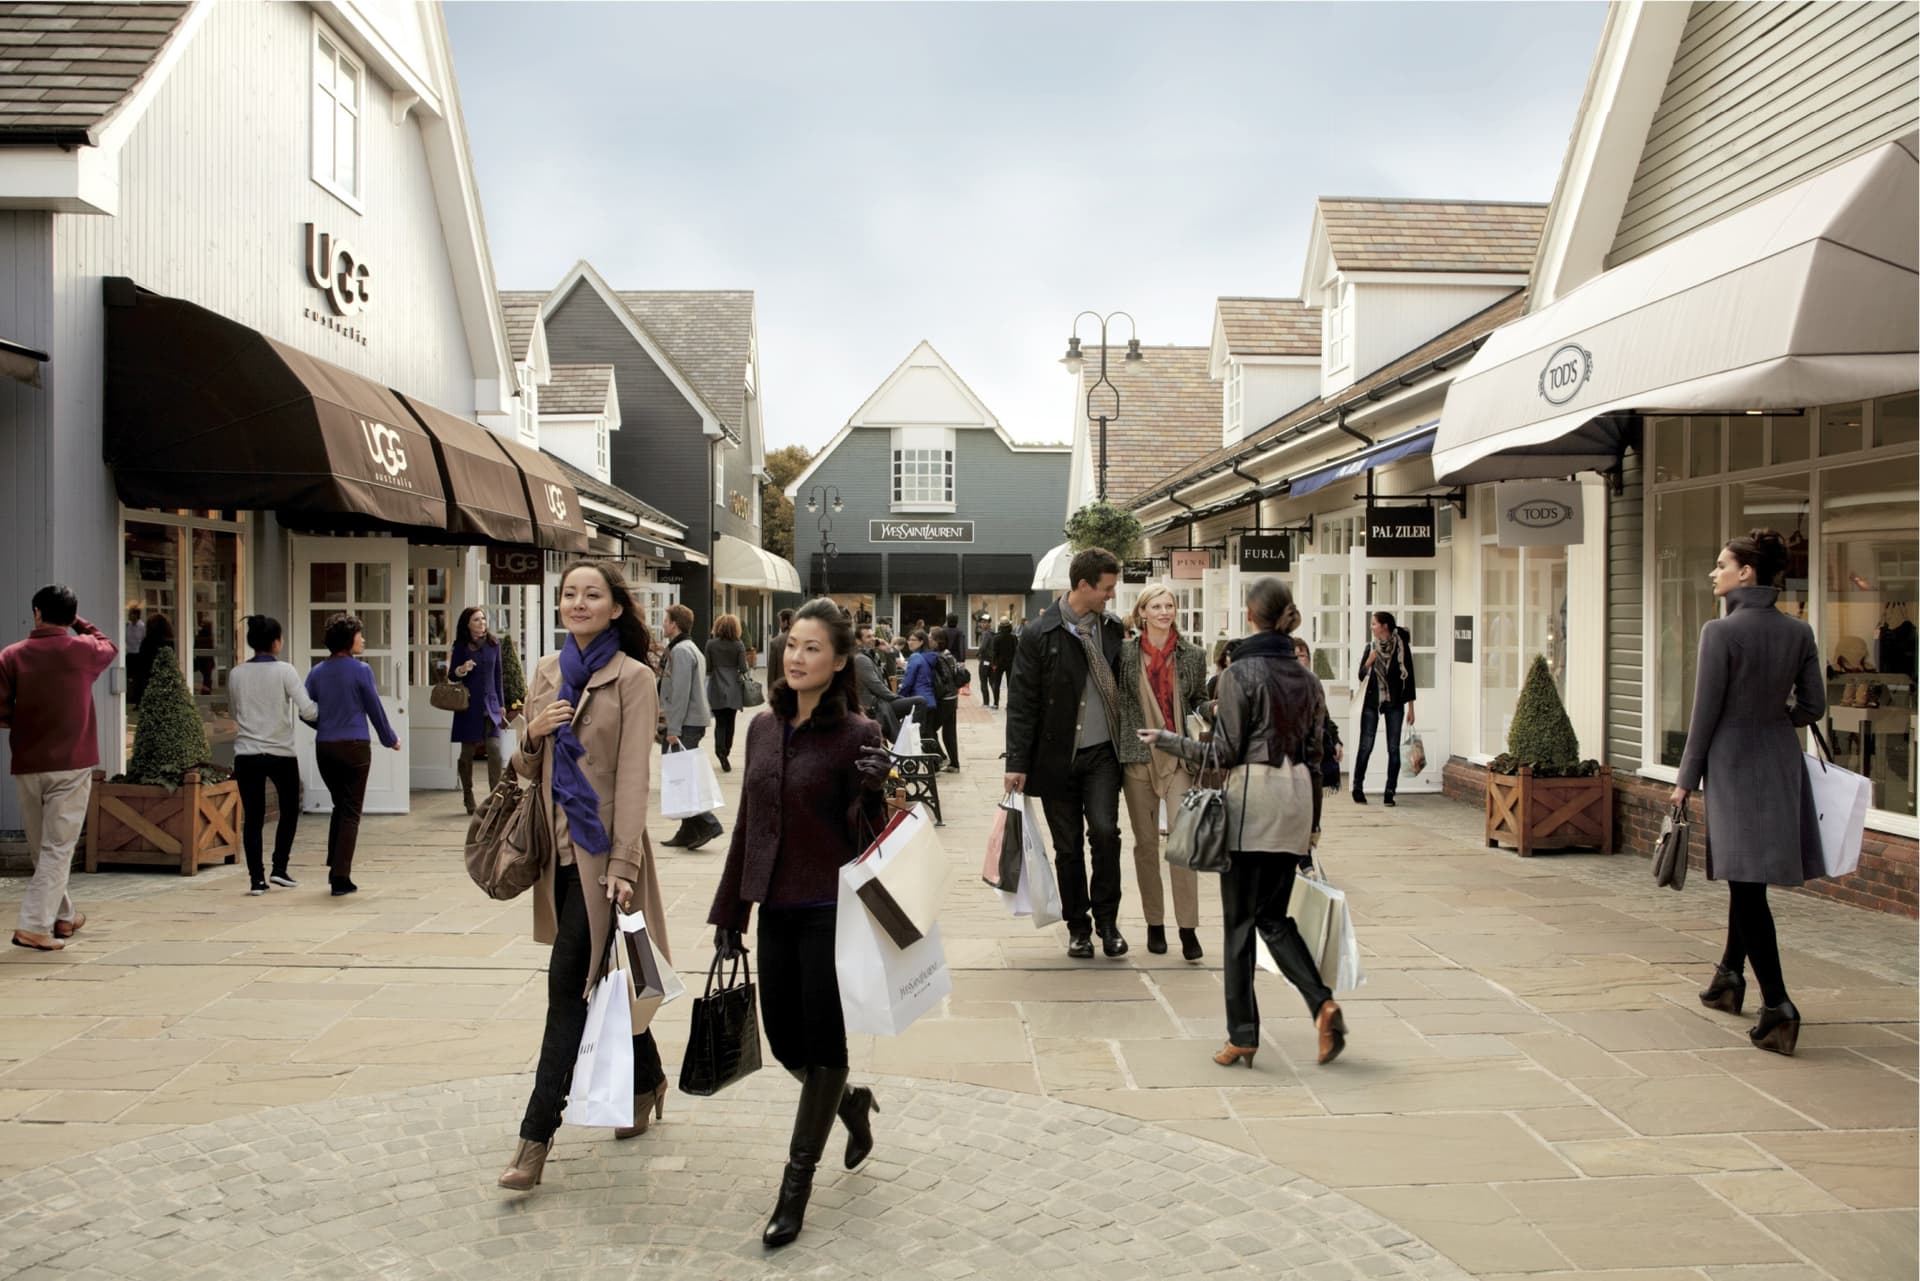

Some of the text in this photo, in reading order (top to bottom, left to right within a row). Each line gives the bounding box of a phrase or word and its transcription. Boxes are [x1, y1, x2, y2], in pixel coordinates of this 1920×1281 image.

[304, 222, 371, 316] UGG
[1550, 359, 1577, 390] TOD'S
[360, 419, 408, 477] UGG
[544, 485, 567, 520] UGG
[1523, 507, 1558, 520] TOD'S
[1372, 525, 1431, 538] PAL ZILERI
[494, 553, 539, 573] UGG
[1244, 549, 1286, 559] FURLA
